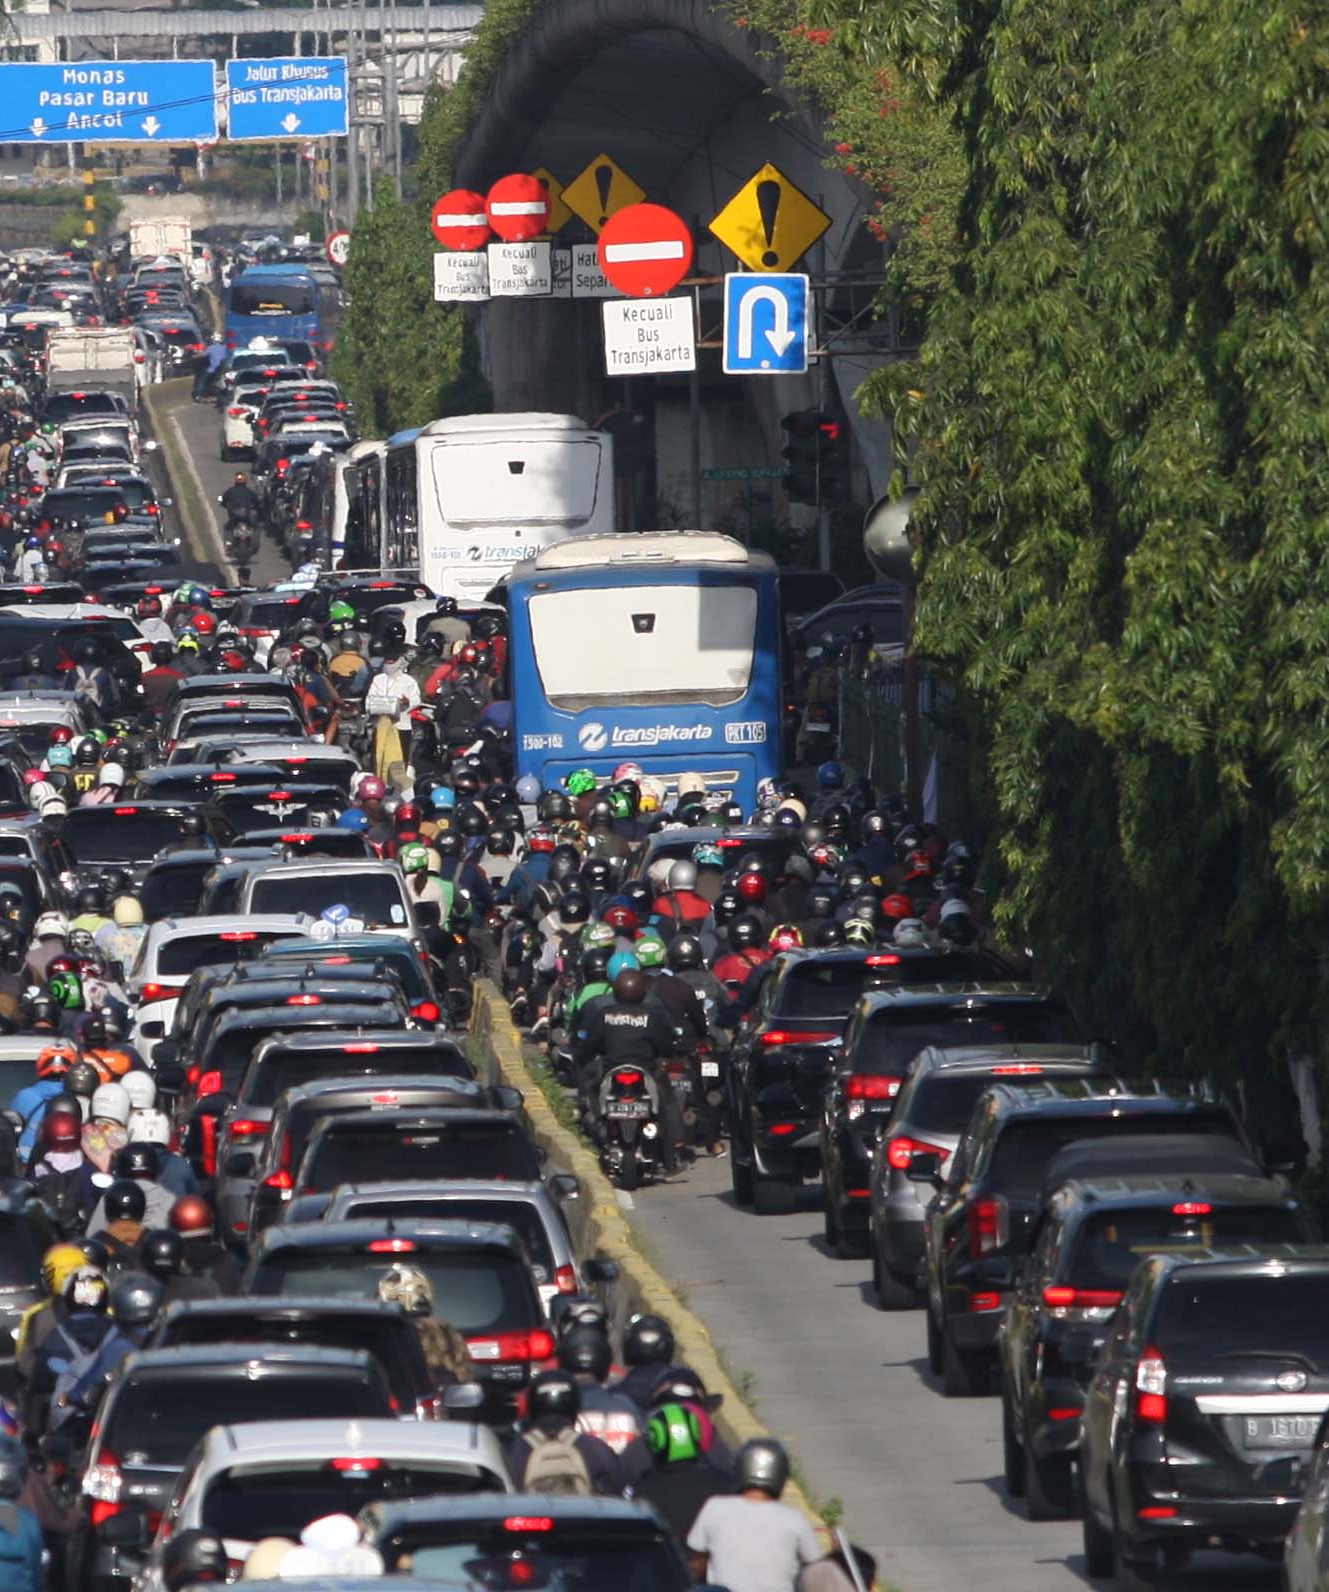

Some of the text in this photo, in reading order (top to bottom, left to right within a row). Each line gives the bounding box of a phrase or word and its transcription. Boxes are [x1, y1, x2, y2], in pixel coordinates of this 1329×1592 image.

[63, 69, 125, 85] Monas
[245, 65, 278, 82] Jalur
[39, 90, 149, 107] Pasar Baru
[232, 84, 343, 106] Bus Transjakarta
[66, 110, 123, 130] Ancol
[502, 247, 537, 261] Kecuali
[577, 251, 599, 266] Hat
[512, 264, 528, 275] Bus
[622, 303, 673, 322] Kecuali
[637, 327, 660, 343] Bus
[610, 344, 691, 367] Transjakarta
[611, 723, 713, 747] transjakarta
[727, 725, 746, 742] PKT
[746, 722, 765, 741] 105
